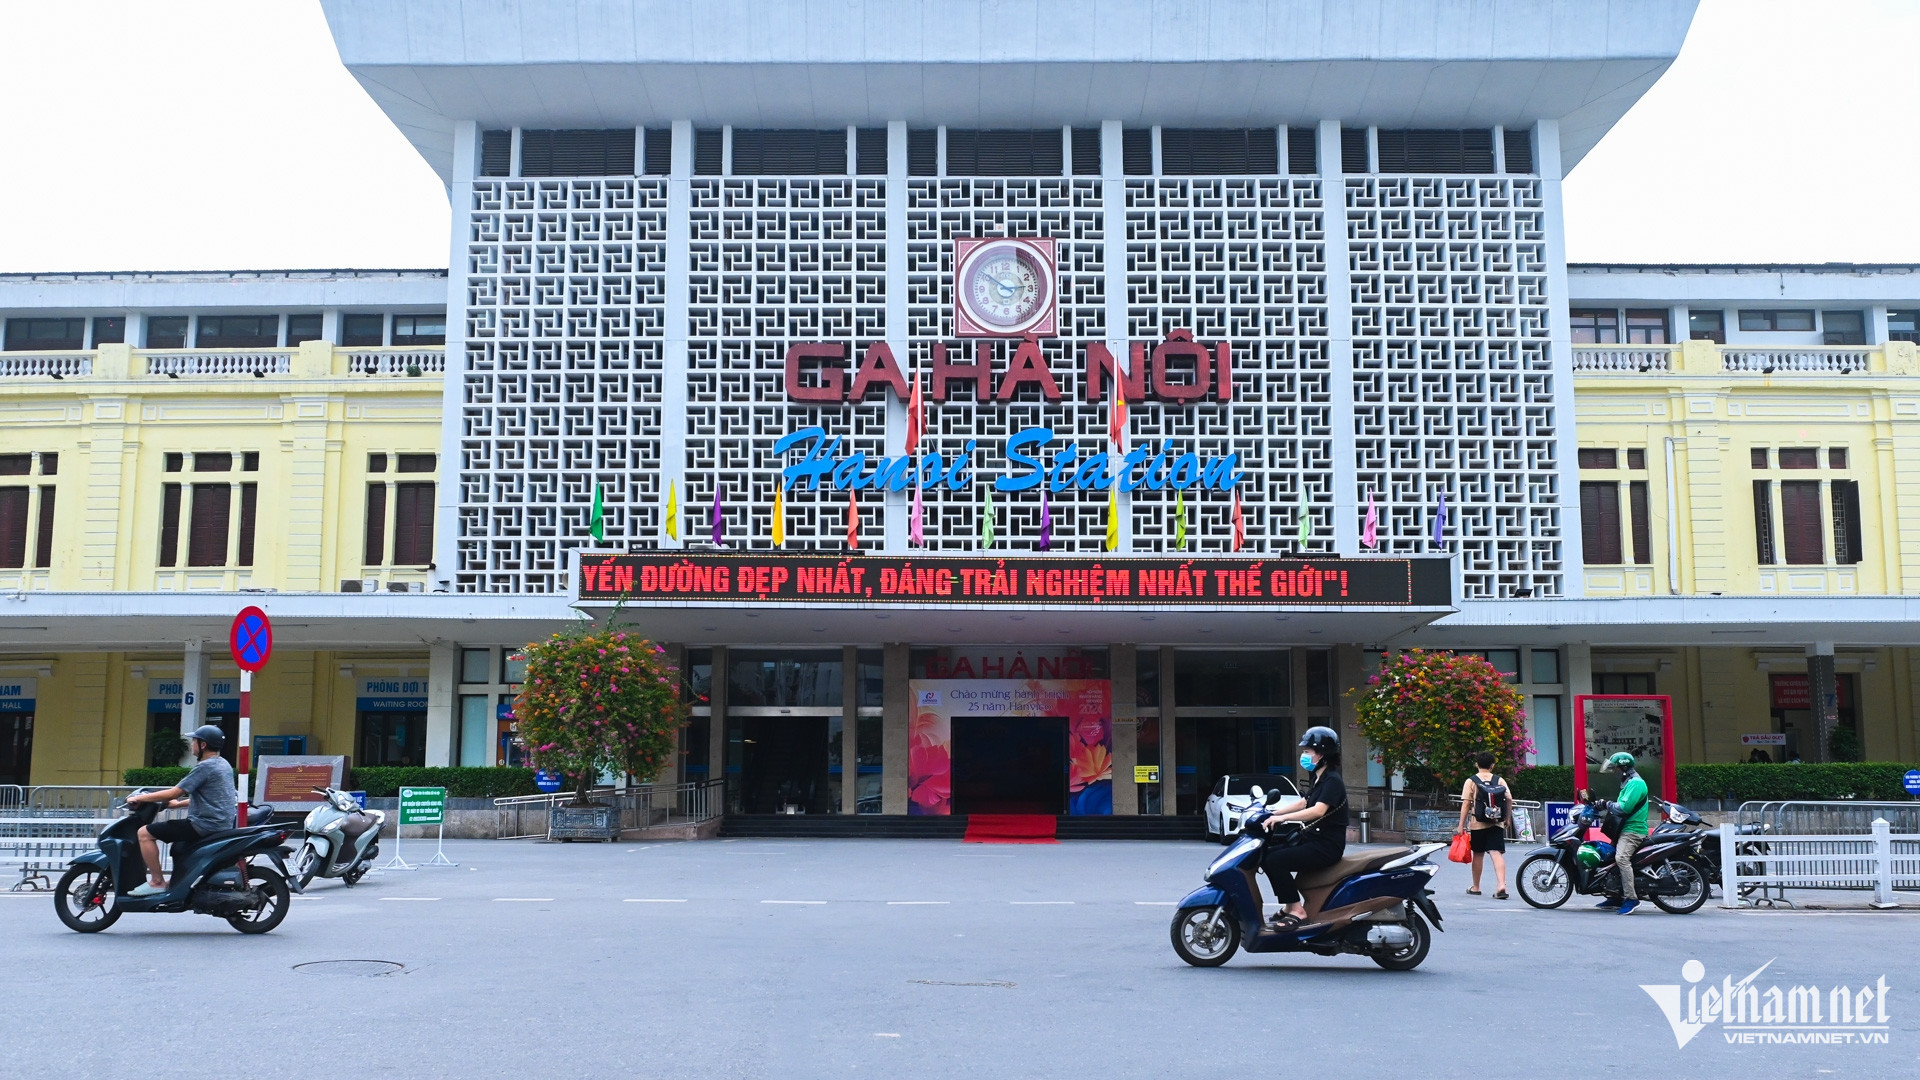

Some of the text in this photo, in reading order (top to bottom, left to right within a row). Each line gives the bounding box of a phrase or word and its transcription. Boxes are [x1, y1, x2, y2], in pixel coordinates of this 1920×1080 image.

[1001, 262, 1010, 271] 12
[1024, 273, 1030, 282] 2
[1023, 296, 1030, 304] 4
[1016, 304, 1022, 312] 5
[784, 327, 1232, 407] GA HÀ NỘI
[773, 426, 1245, 494] Hanoi Station
[582, 556, 633, 592] YẾN
[640, 558, 730, 593] ĐƯỜNG
[737, 566, 789, 599] ĐẸP
[796, 557, 873, 598] NHẤT,
[880, 562, 952, 595] ĐÁNG
[959, 559, 1018, 596] TRẢI
[1026, 563, 1130, 603] NGHIỆM
[1138, 560, 1207, 596] NHẤT
[1213, 561, 1262, 597] THẾ
[925, 656, 977, 679] GA
[159, 681, 183, 694] PHÒN
[212, 681, 230, 694] TÀU
[366, 680, 400, 692] PHÒNG
[402, 681, 418, 695] ĐỢI
[185, 692, 194, 705] 6
[950, 689, 978, 699] Chào
[980, 689, 1010, 700] mừng
[1014, 689, 1040, 699] hành
[1825, 694, 1835, 707] 7
[968, 702, 1052, 712] 25 năm Hanvico
